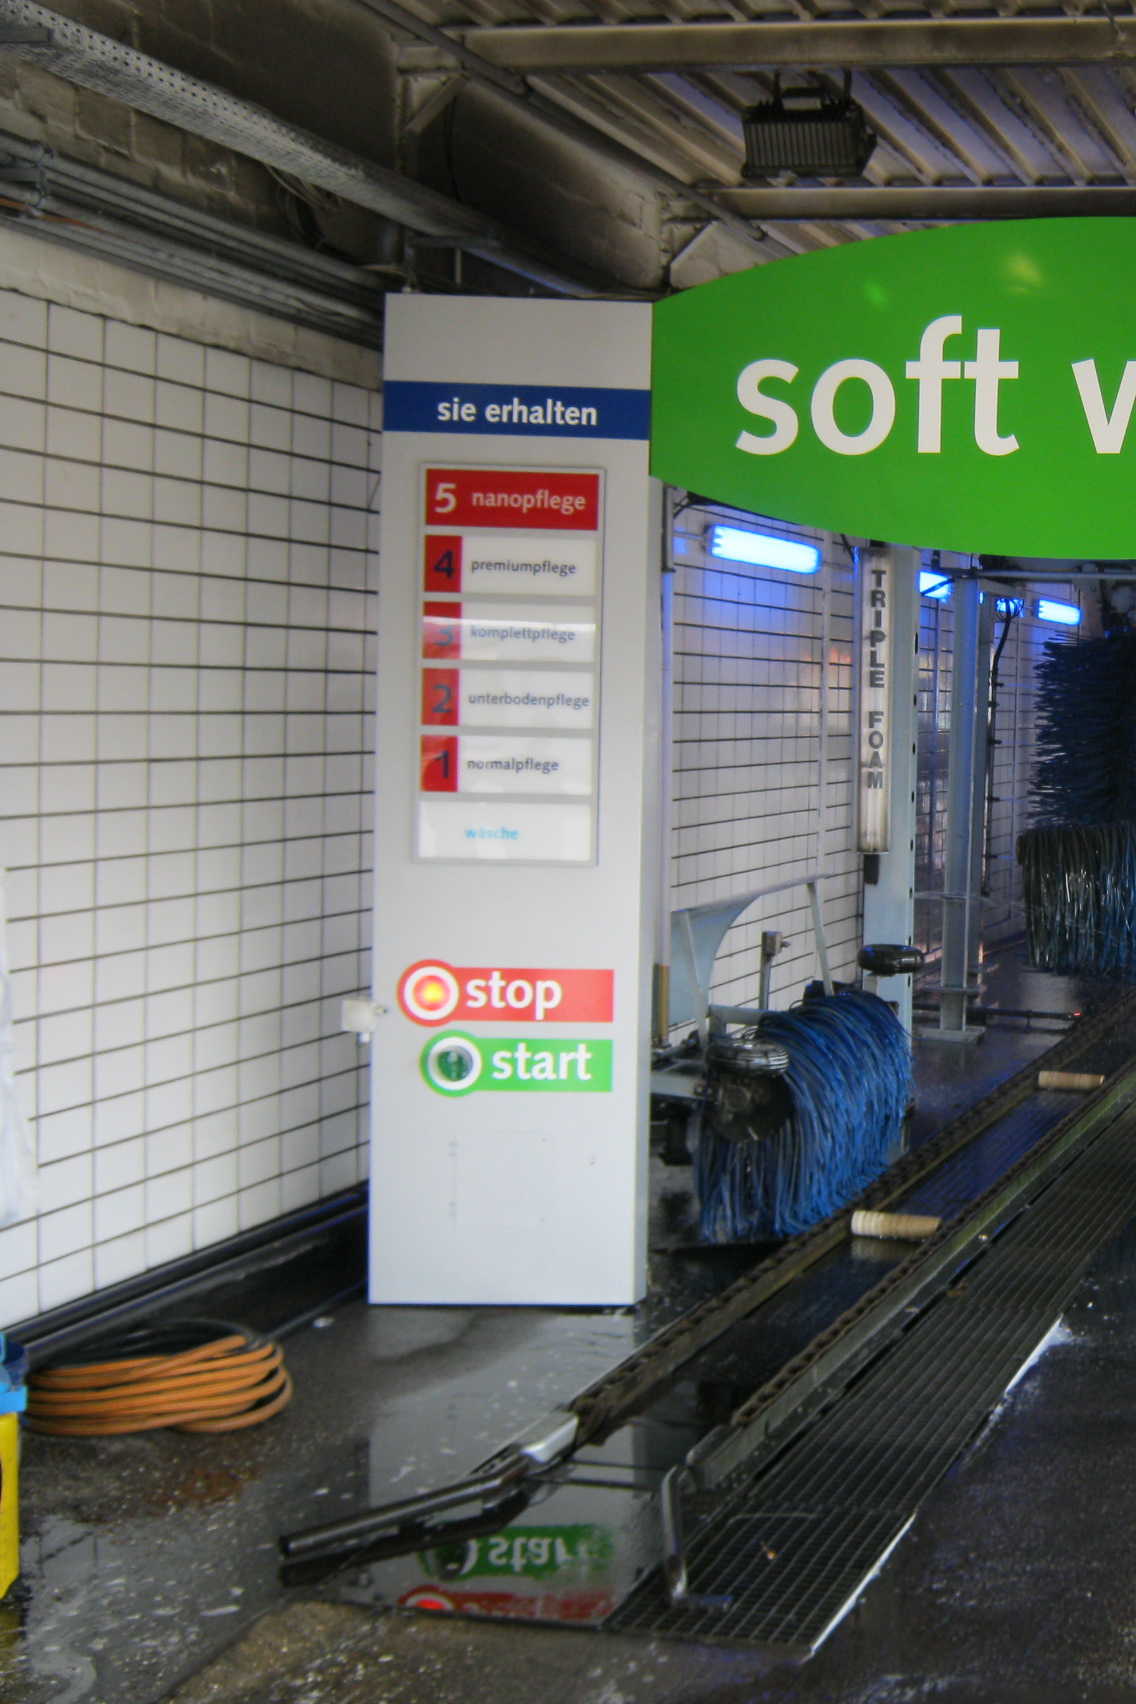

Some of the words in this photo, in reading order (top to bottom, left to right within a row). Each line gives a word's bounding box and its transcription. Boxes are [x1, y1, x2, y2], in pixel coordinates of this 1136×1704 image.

[735, 314, 1019, 456] soft
[437, 397, 476, 422] sie
[485, 398, 597, 426] erhalten
[434, 483, 456, 514] 5
[472, 489, 586, 514] nanopflege
[433, 550, 455, 578] 4
[471, 558, 576, 576] premiumpflege
[434, 618, 455, 647] 3
[470, 624, 575, 643] komplettpflege
[869, 570, 887, 689] TRIPLE
[432, 684, 452, 713] 2
[468, 692, 590, 710] unterbodenpflege
[435, 750, 449, 778] 1
[467, 758, 559, 774] normalpflege
[867, 711, 884, 789] FOAM
[465, 826, 519, 840] wäsche
[465, 971, 563, 1020] stop
[491, 1043, 592, 1082] start
